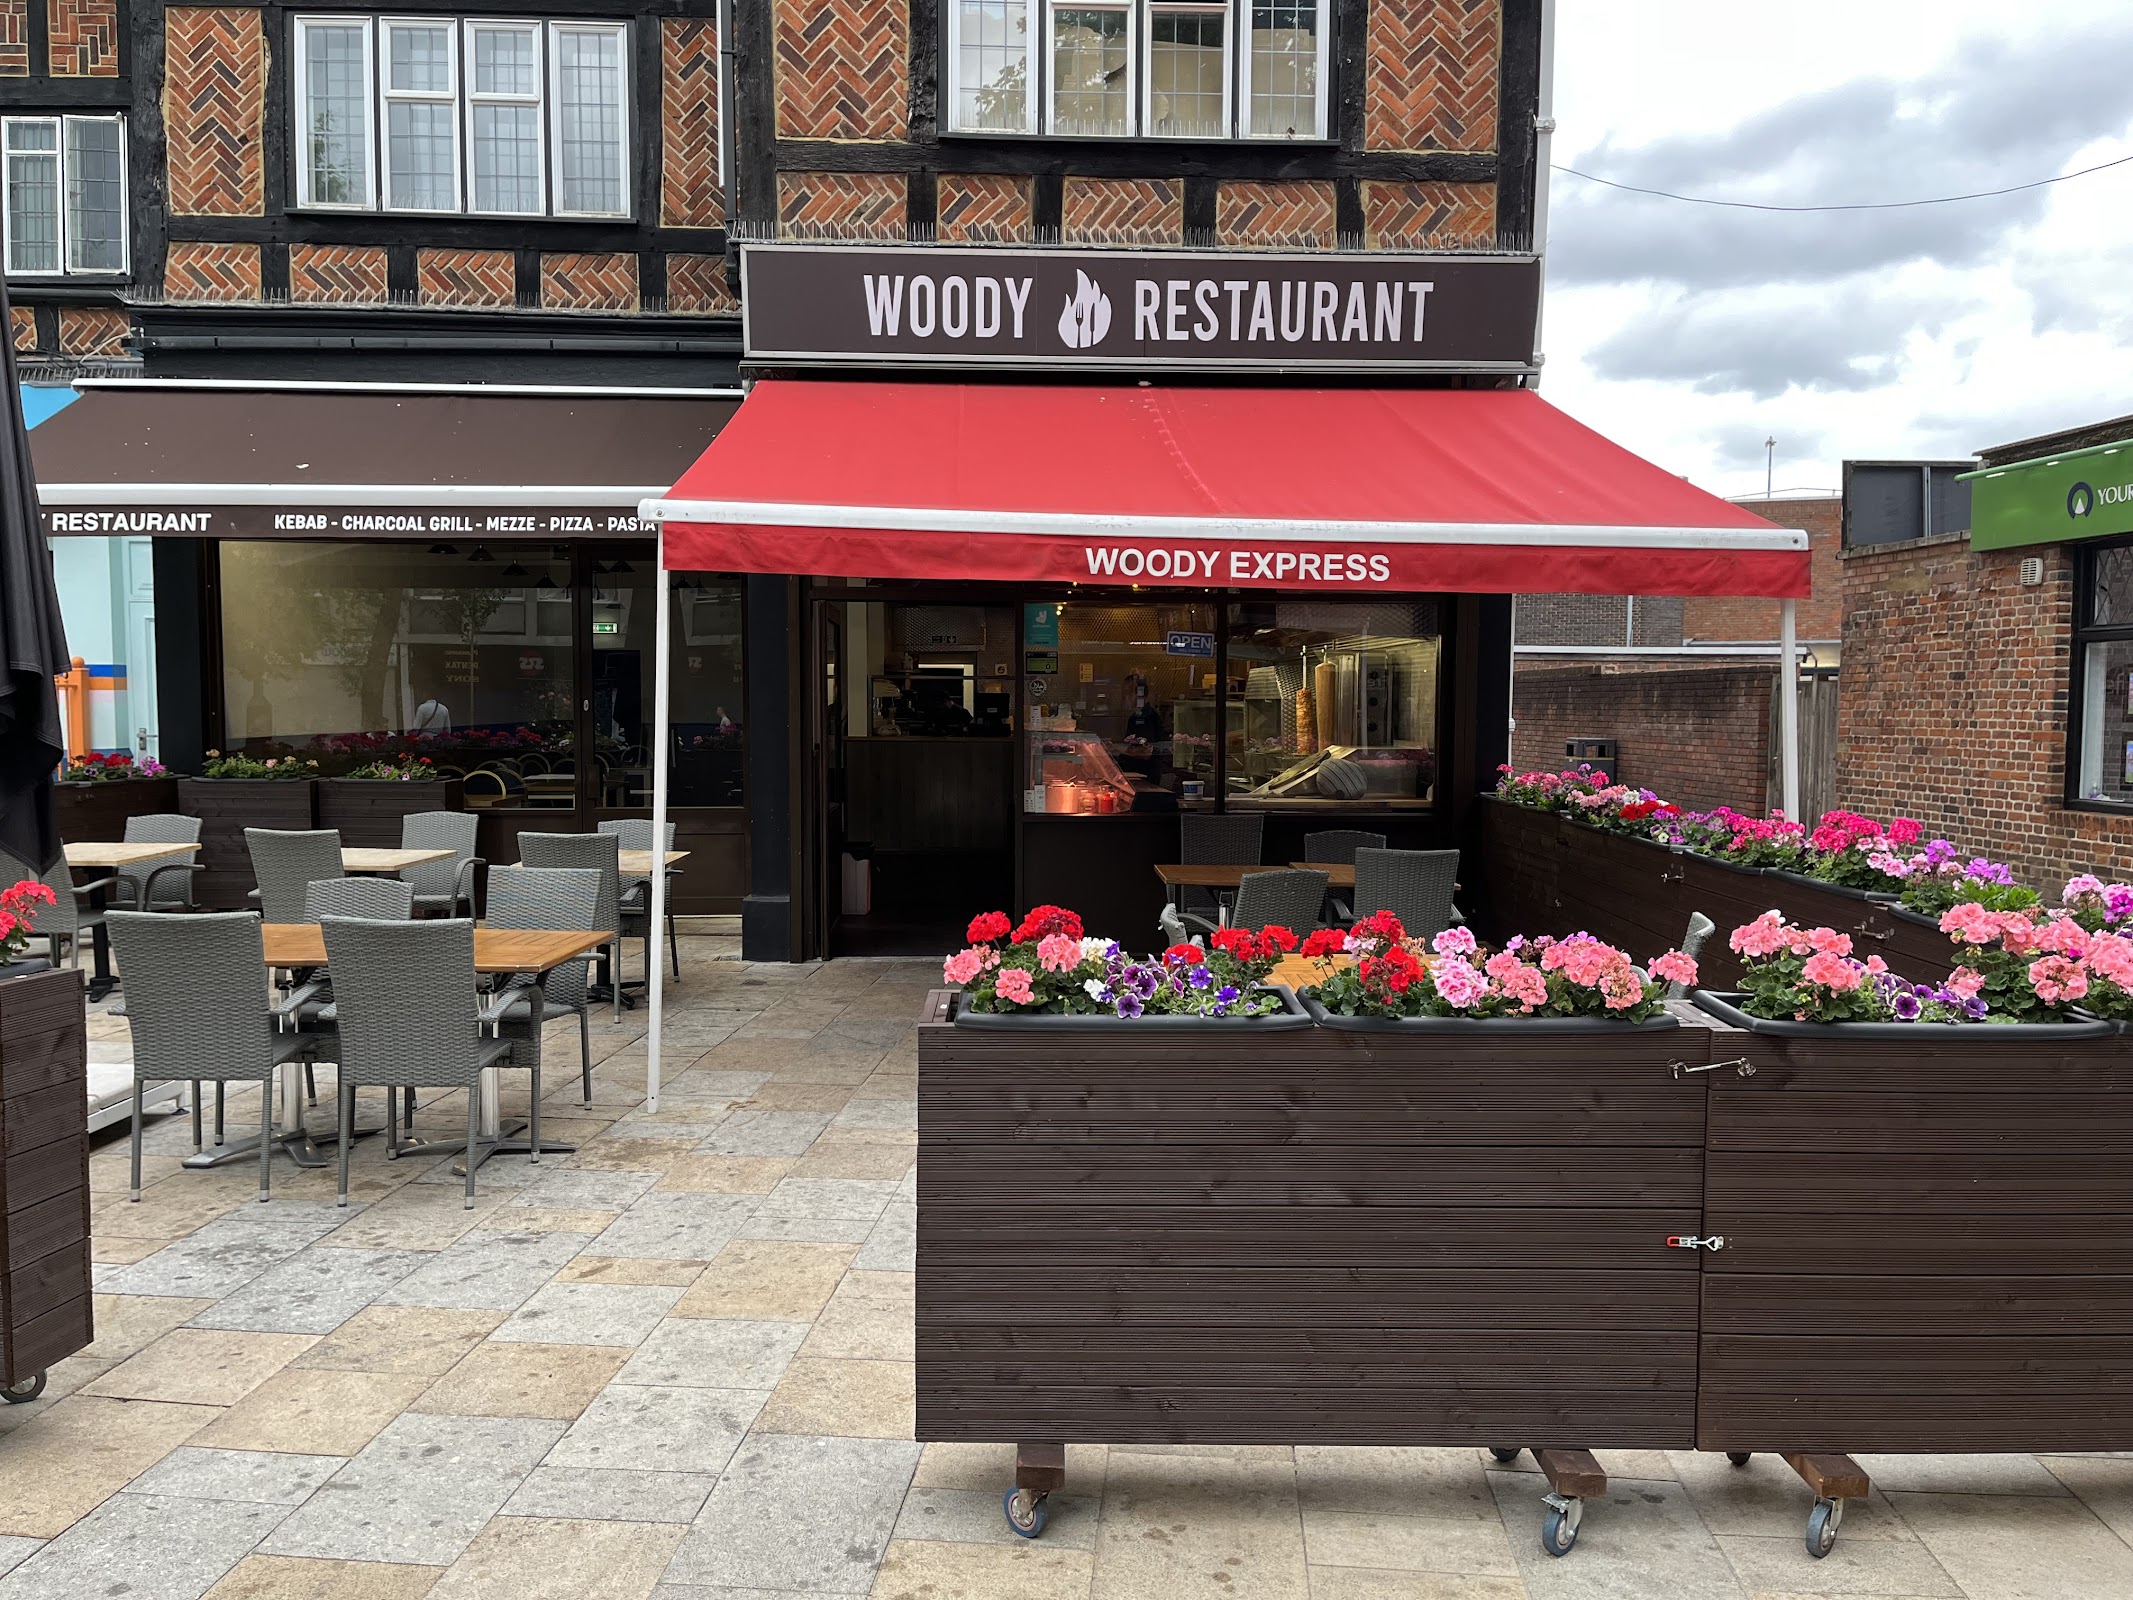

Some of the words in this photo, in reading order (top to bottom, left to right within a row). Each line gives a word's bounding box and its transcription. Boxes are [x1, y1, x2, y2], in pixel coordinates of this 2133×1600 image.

[864, 275, 1033, 339] WOODY
[1135, 279, 1433, 342] RESTAURANT
[52, 513, 211, 531] RESTAURANT
[274, 514, 327, 530] KEBAB
[342, 515, 426, 531] CHARCOAL
[429, 516, 473, 532] GRILL
[486, 517, 536, 531] MEZZE
[550, 517, 593, 531] PIZZA
[1086, 547, 1220, 578] WOODY
[1231, 551, 1390, 582] EXPRESS
[1170, 635, 1211, 649] OPEN
